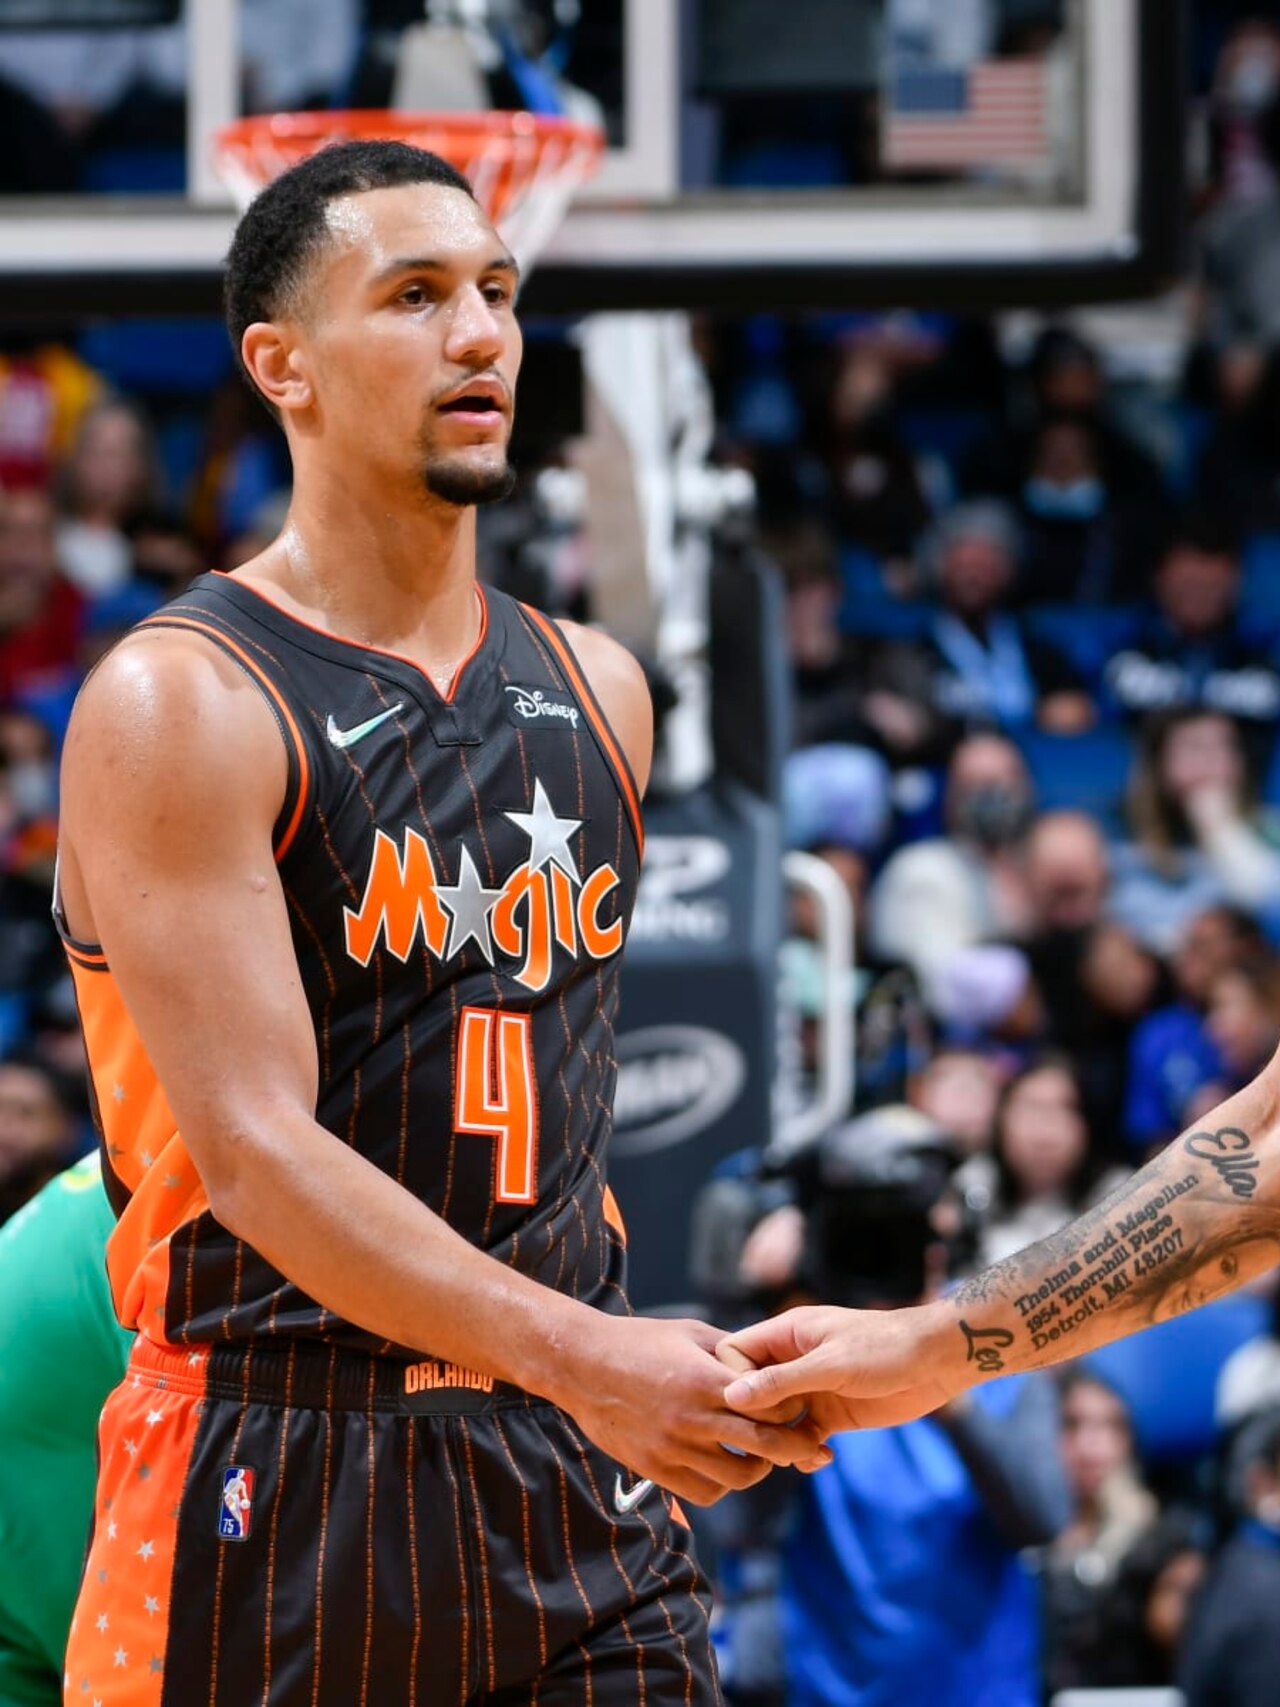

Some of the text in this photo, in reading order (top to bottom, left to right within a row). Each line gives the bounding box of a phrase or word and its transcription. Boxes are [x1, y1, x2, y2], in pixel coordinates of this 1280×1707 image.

[504, 685, 578, 729] Disney
[454, 1006, 540, 1206] 4
[1183, 1127, 1260, 1198] Ella
[1013, 1174, 1199, 1318] Thelma and Magellan
[1026, 1214, 1173, 1334] 1954 Thornhill Place
[1101, 1269, 1133, 1301] MI
[1134, 1227, 1184, 1277] 48207
[223, 1518, 235, 1534] 75
